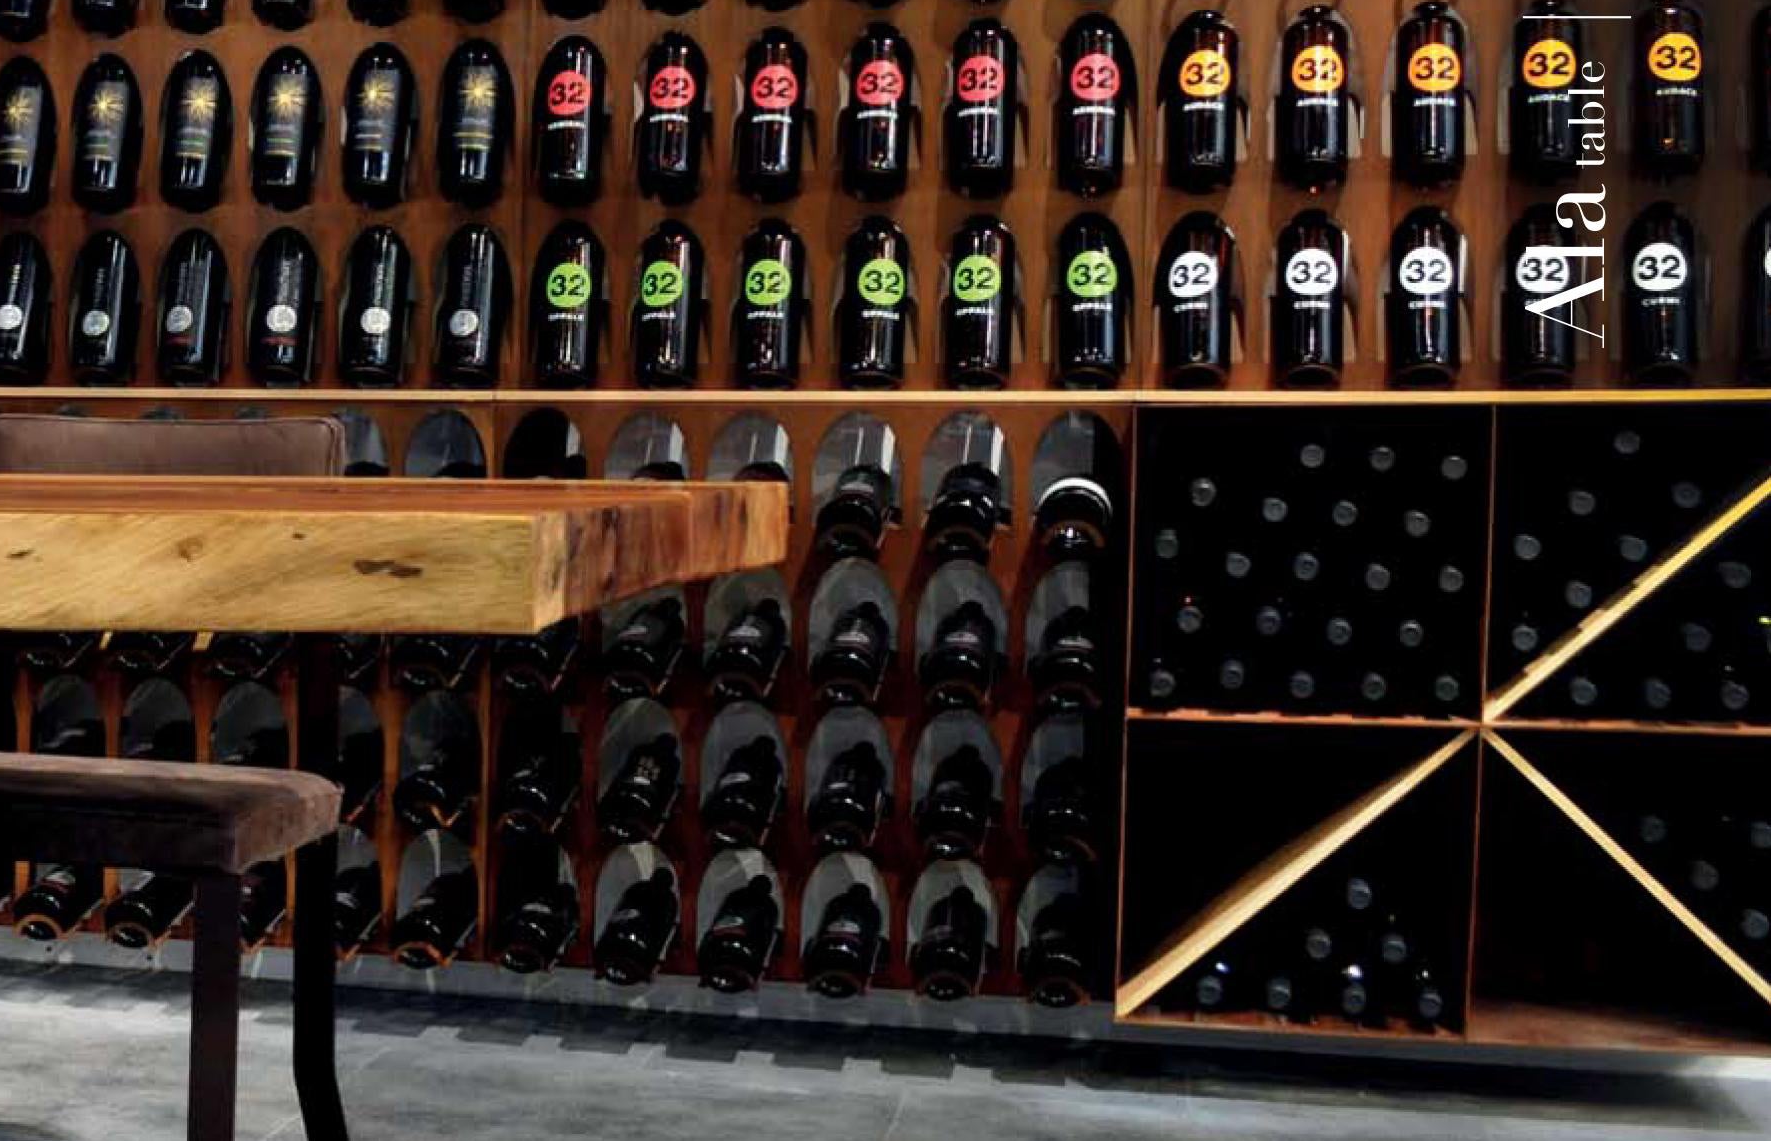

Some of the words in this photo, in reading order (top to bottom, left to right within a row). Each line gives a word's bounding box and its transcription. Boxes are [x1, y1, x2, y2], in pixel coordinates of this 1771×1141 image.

[1299, 57, 1337, 82] 32
[1415, 56, 1454, 81] 32
[1529, 52, 1569, 76] 32
[1656, 45, 1695, 71] 32
[756, 75, 794, 99] 32
[859, 70, 898, 96] 32
[959, 64, 998, 92] 32
[1077, 65, 1115, 90] 32
[1185, 62, 1223, 87] 32
[549, 79, 585, 106] 32
[652, 75, 689, 100] 32
[957, 266, 994, 292] 32
[1072, 262, 1109, 288] 32
[1173, 262, 1210, 288] 32
[1291, 260, 1331, 284] 32
[1407, 258, 1447, 284] 32
[1522, 258, 1564, 282] 32
[1638, 254, 1680, 281] 32
[549, 274, 585, 298] 32
[642, 270, 677, 298] 32
[747, 271, 783, 296] 32
[864, 269, 901, 296] 32
